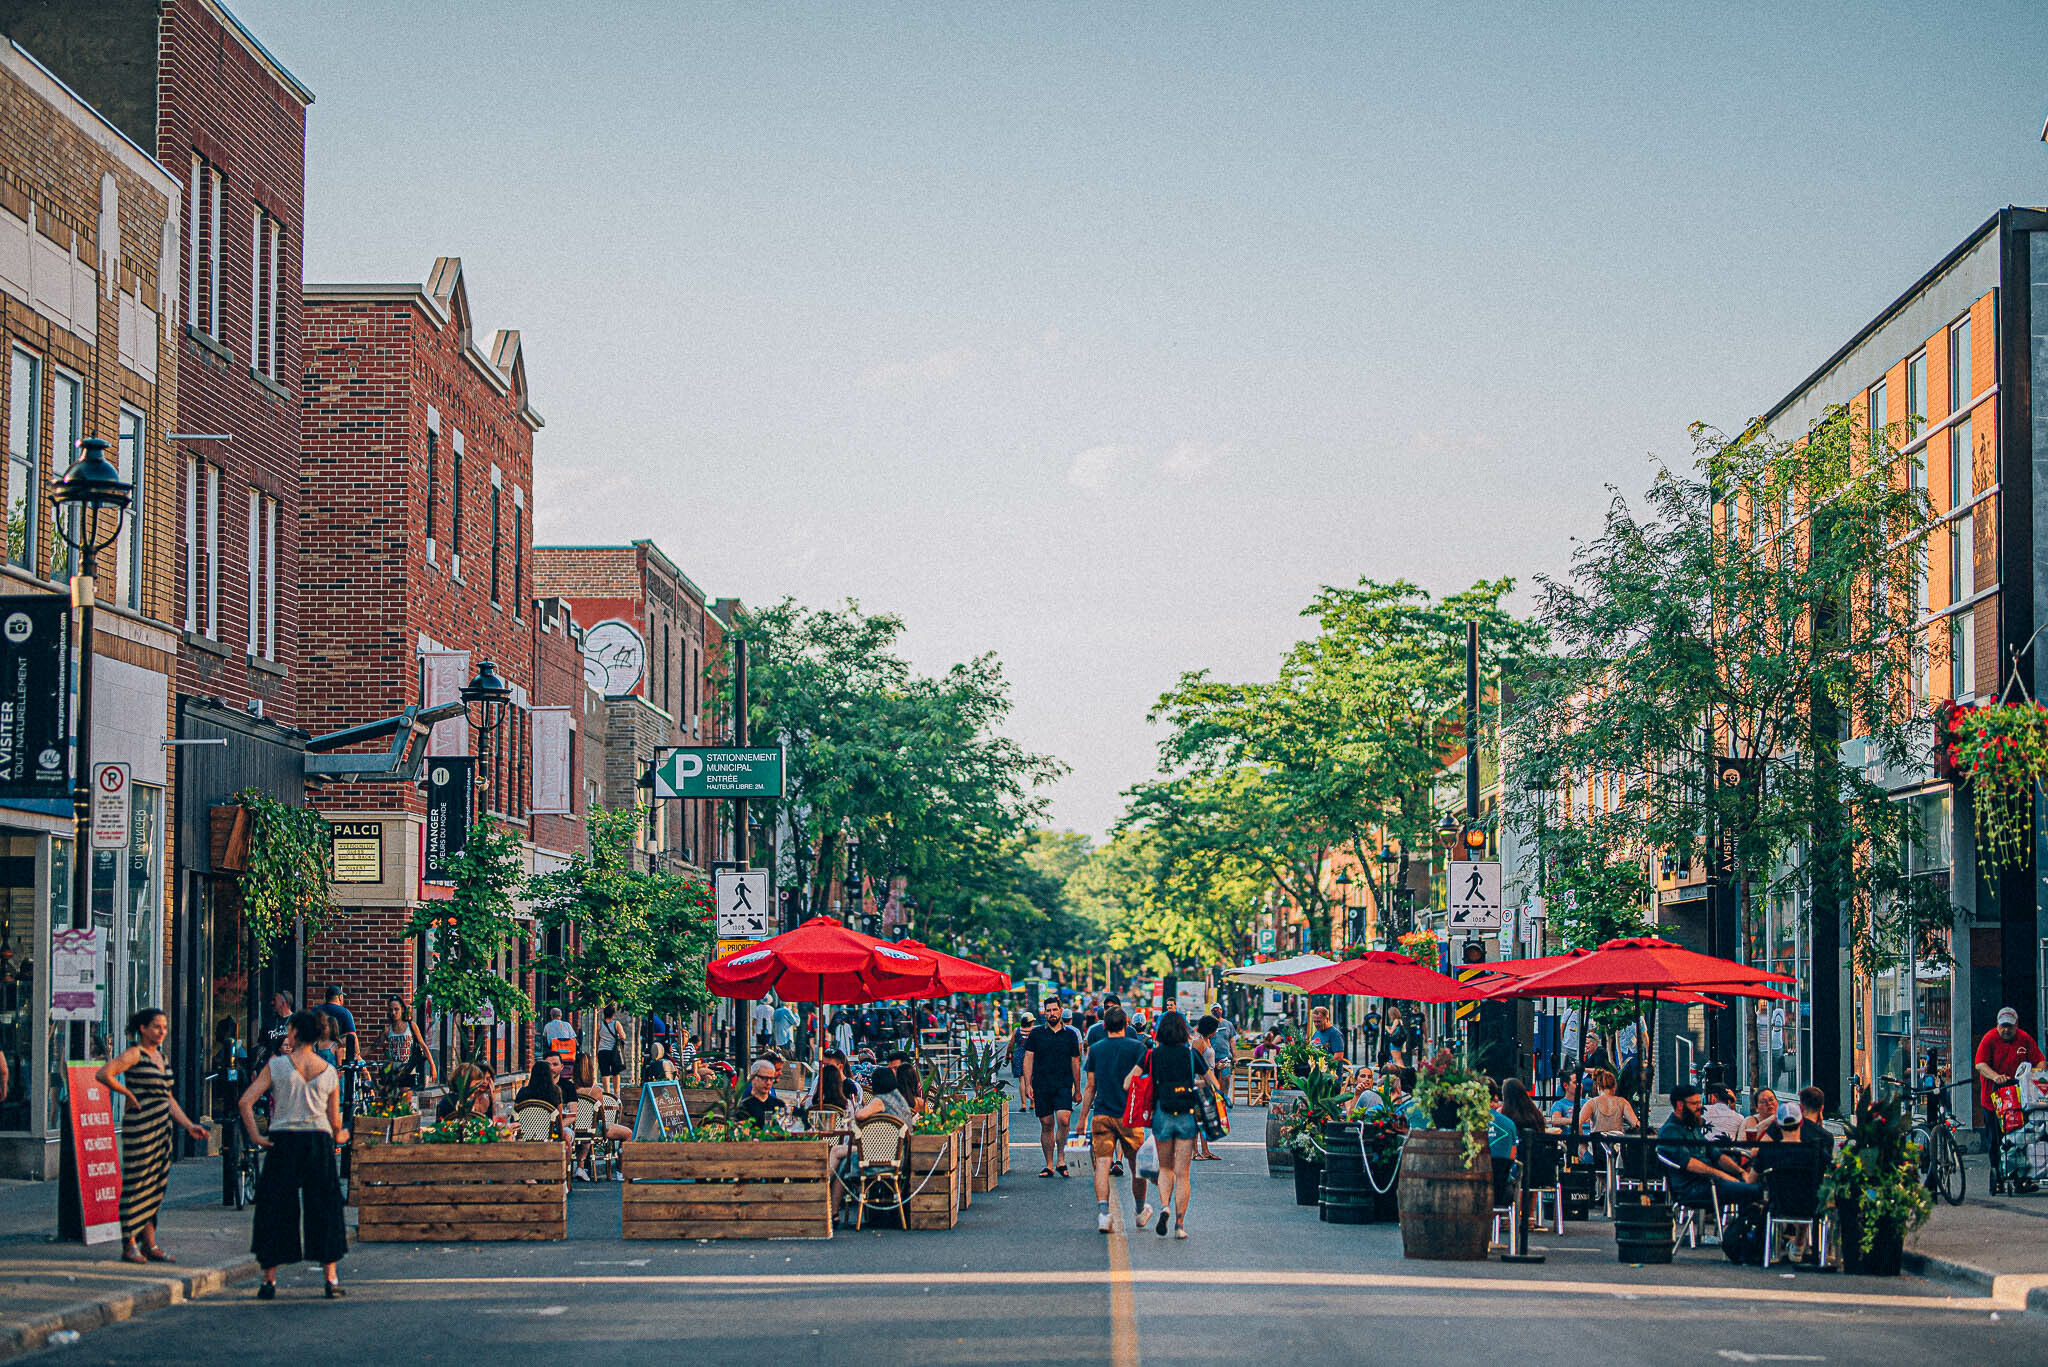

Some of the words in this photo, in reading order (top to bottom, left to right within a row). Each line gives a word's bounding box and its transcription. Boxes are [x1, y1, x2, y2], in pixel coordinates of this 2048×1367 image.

[15, 656, 28, 748] NATURELLEMENT
[0, 701, 14, 763] VISITER
[14, 752, 25, 779] TOUT
[706, 753, 777, 762] STATIONNEMENT
[675, 753, 703, 790] P
[706, 764, 752, 772] MUNICIPAL
[706, 774, 738, 783] ENTRÉE
[334, 824, 379, 835] PALCO
[429, 808, 439, 852] MANGER
[440, 827, 447, 838] DU
[428, 854, 438, 870] OÙ
